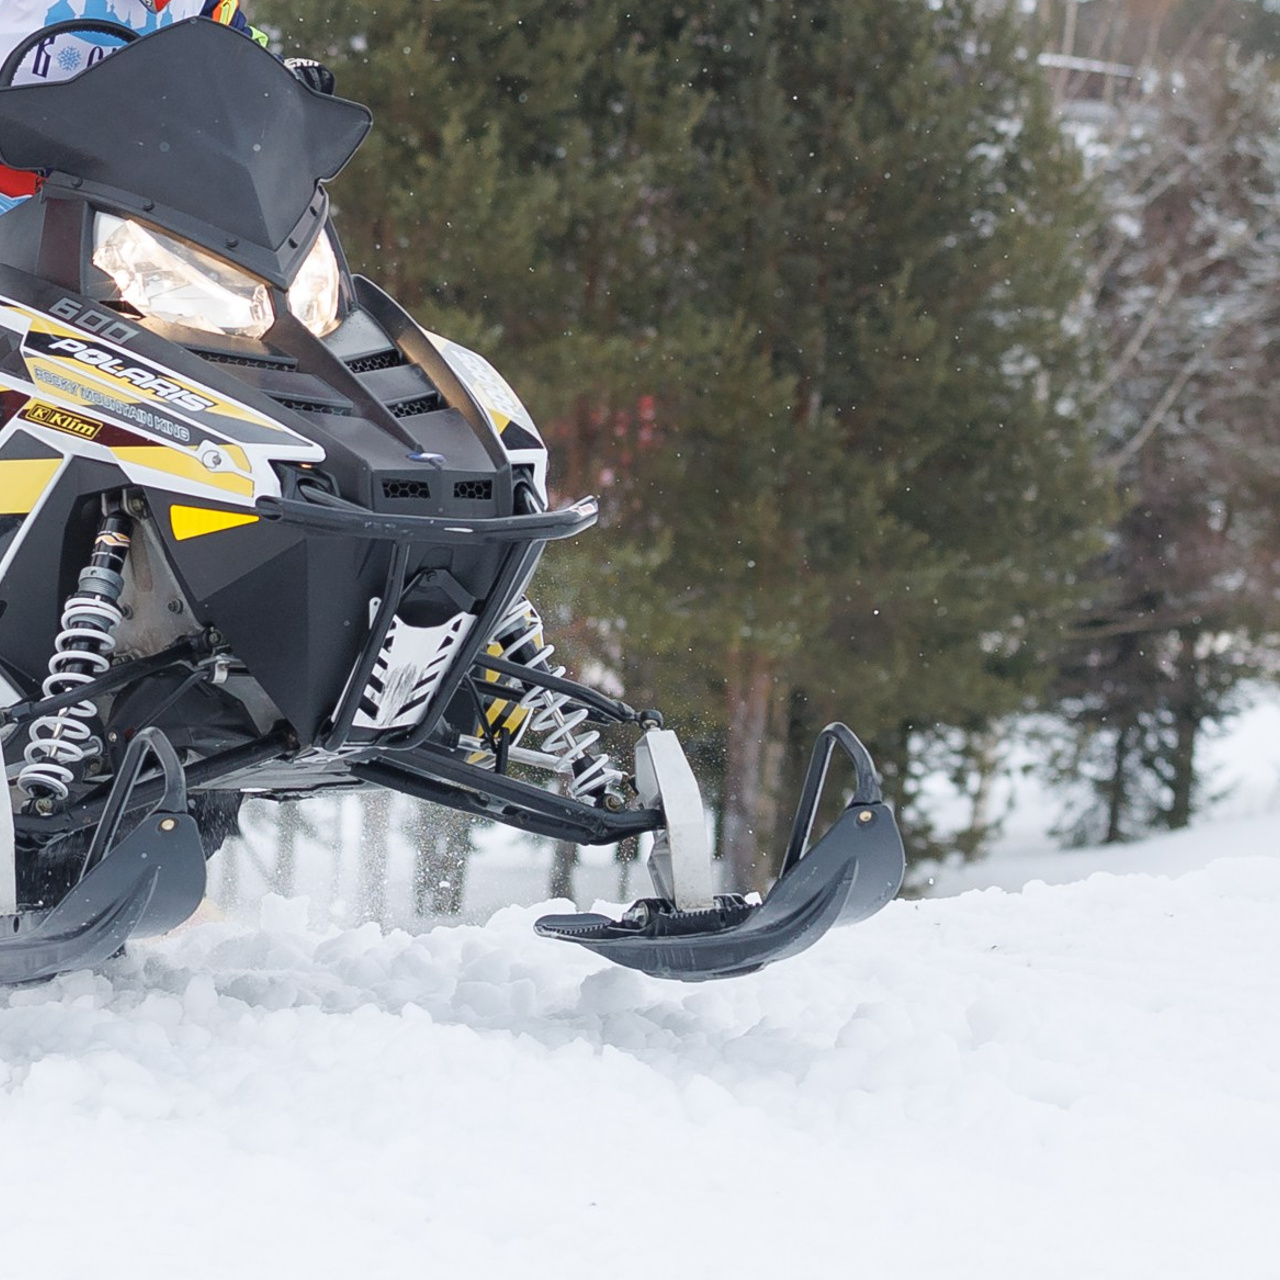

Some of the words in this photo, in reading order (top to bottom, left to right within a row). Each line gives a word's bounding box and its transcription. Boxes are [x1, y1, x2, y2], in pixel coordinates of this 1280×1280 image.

[48, 297, 140, 345] 600
[34, 367, 79, 396] ROCKY
[81, 385, 154, 427] MOUNTAIN
[154, 416, 191, 442] KING
[48, 338, 216, 412] POLARIS
[50, 410, 96, 437] Klim
